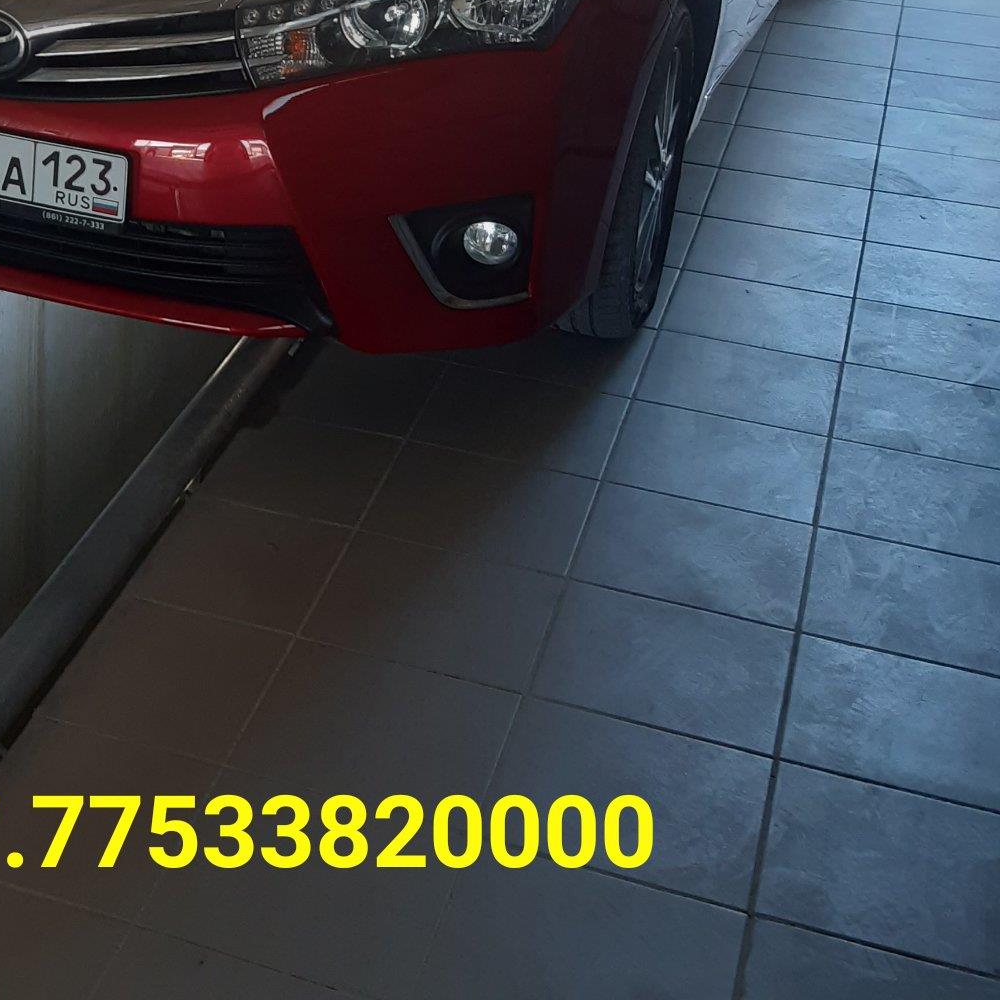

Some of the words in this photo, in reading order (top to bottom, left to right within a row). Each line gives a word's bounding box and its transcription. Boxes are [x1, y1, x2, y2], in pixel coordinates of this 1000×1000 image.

[42, 151, 112, 195] 123
[55, 190, 90, 209] RUS
[65, 216, 105, 230] 222-7-333
